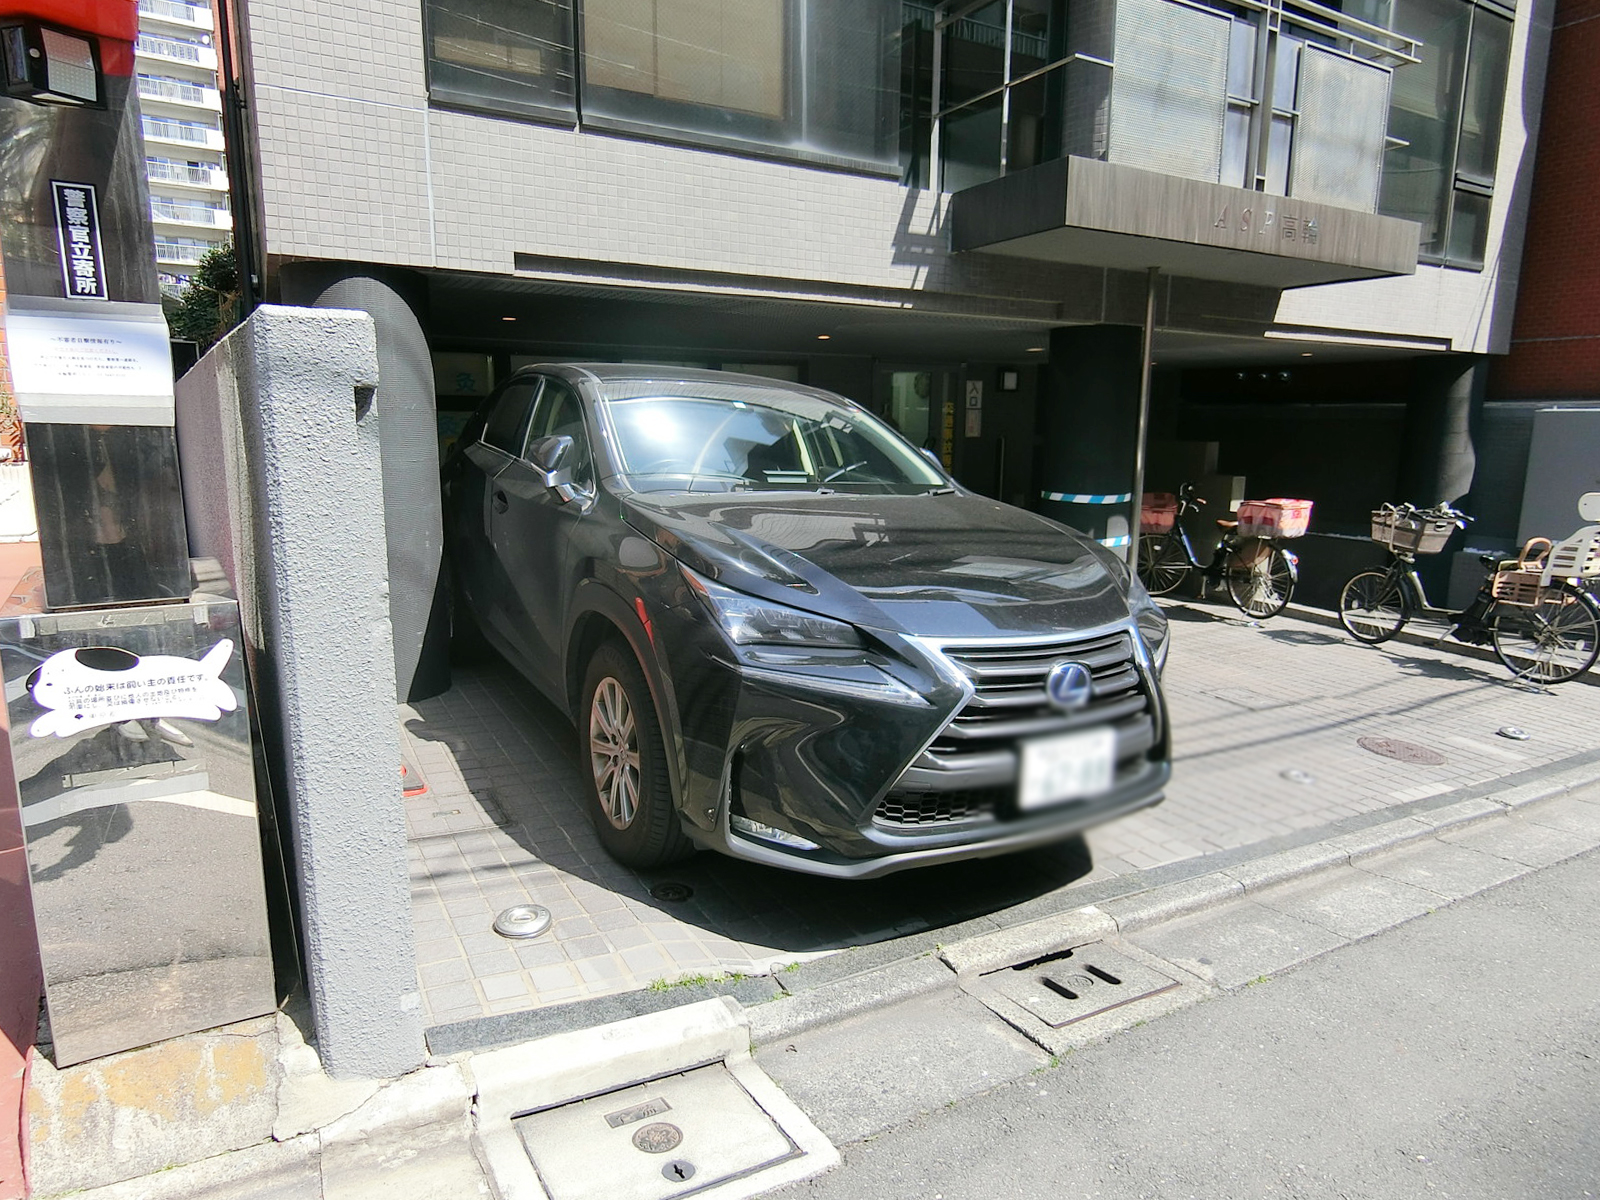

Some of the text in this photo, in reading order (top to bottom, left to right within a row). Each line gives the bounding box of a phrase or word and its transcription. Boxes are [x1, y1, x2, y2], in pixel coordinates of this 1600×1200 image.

[63, 188, 98, 295] 警察官立寄所
[969, 382, 979, 407] 入口
